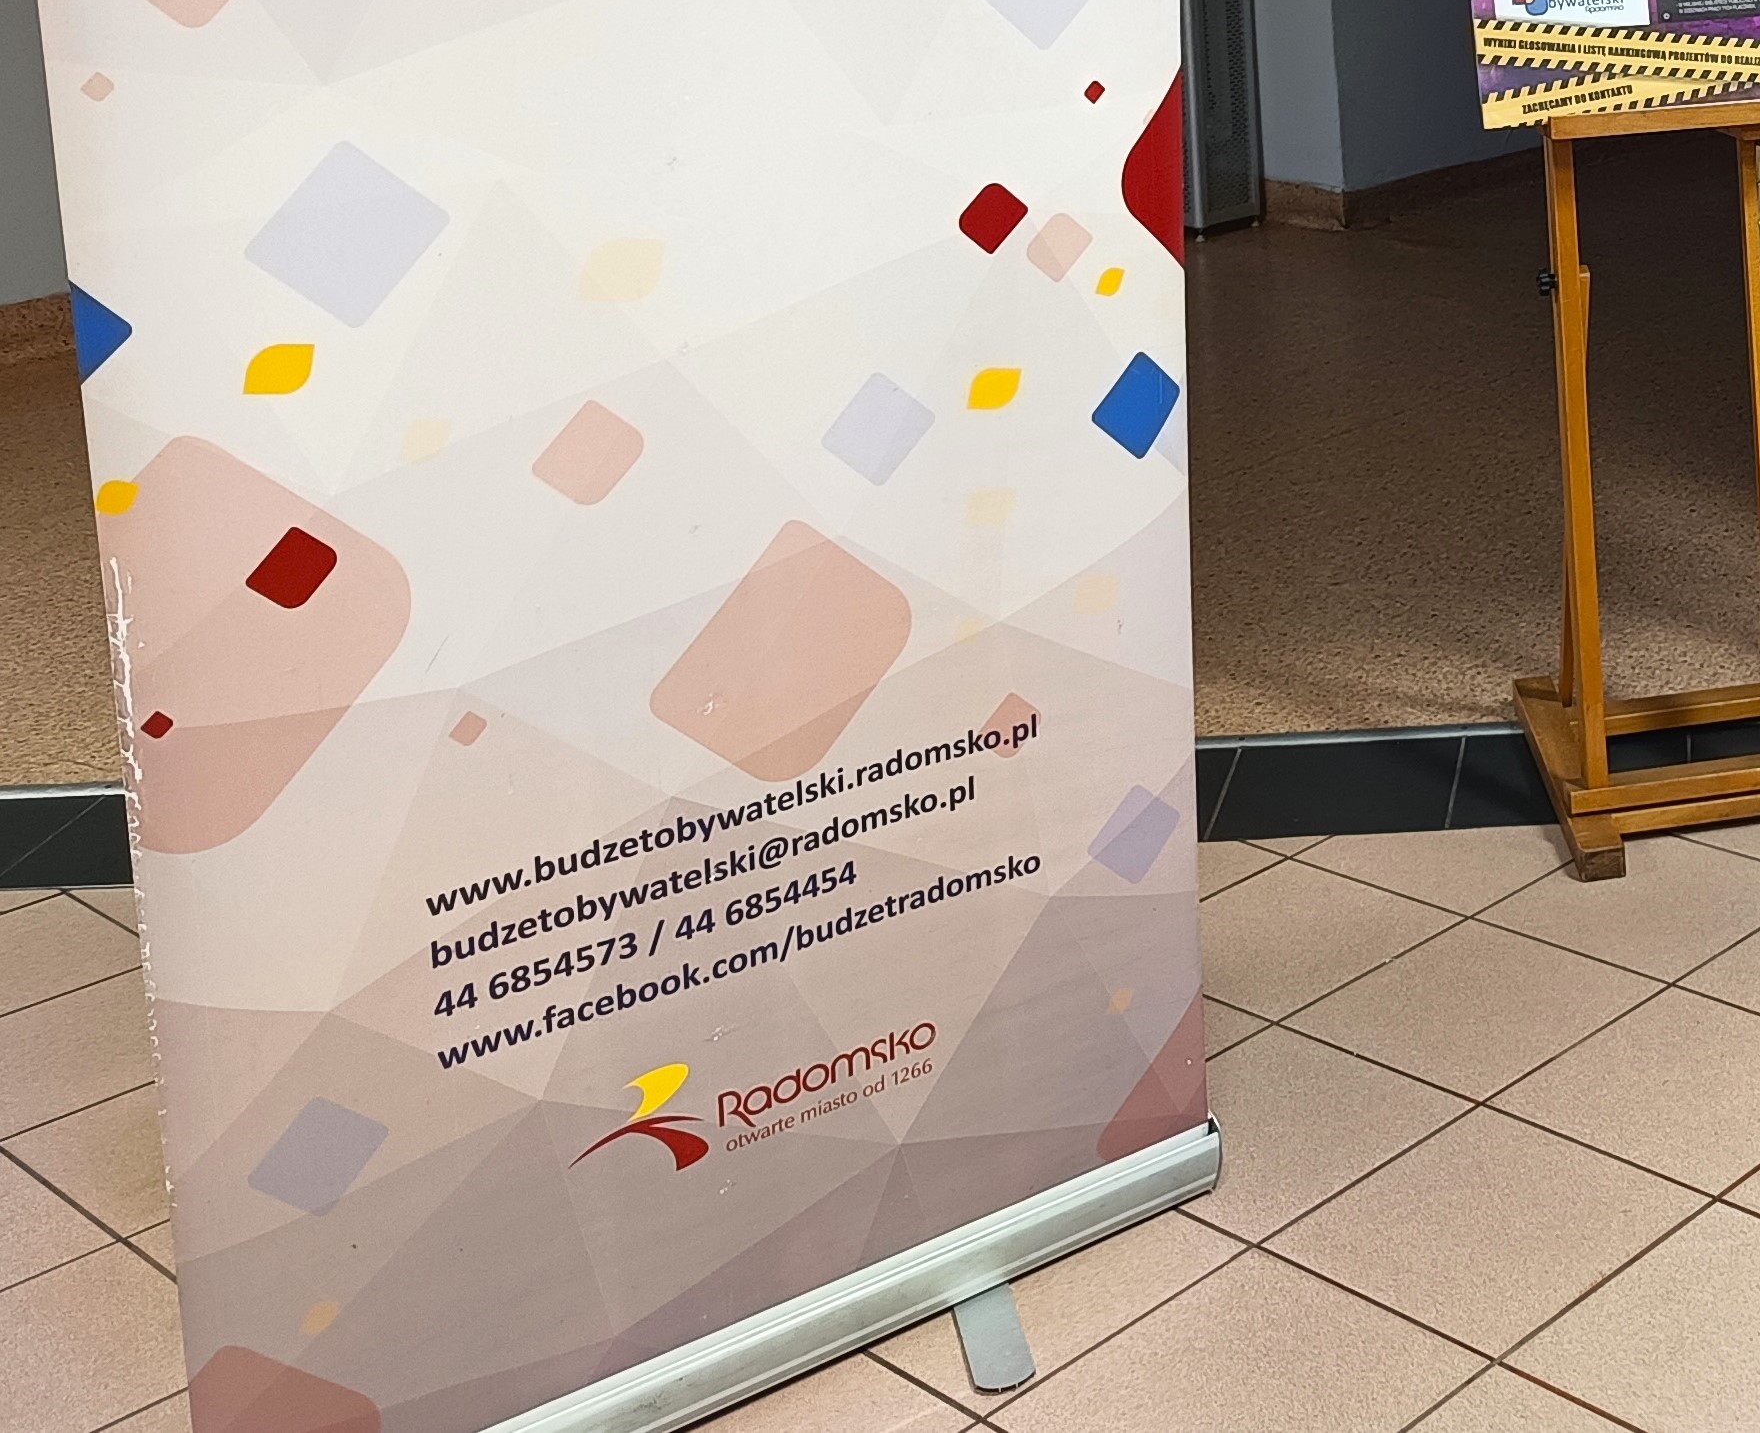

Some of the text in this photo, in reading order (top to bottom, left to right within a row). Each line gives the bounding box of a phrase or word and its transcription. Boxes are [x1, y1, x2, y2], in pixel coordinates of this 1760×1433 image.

[1483, 37, 1516, 48] WYNIKI
[1519, 40, 1575, 53] GŁOSOWANIA
[1578, 43, 1581, 54] I
[1583, 44, 1606, 56] LISTĘ
[1608, 46, 1666, 61] RANKINGOWĄ
[1668, 50, 1718, 63] PROJEKTÓW
[1721, 54, 1732, 64] DO
[1522, 85, 1632, 114] ZACHĘCAMY DO KONTAKTU
[426, 714, 1039, 918] www.budzetobywatelski.radomsko.pl
[431, 777, 976, 969] budzetobywatelski@radomsko.pl
[433, 861, 857, 1019] 44 6854573 / 44 6854454
[438, 853, 1041, 1070] www.facebook.com/budzetradomsko
[717, 1021, 937, 1127] Radomsko
[725, 1059, 933, 1153] otwarte miasto od 1266
